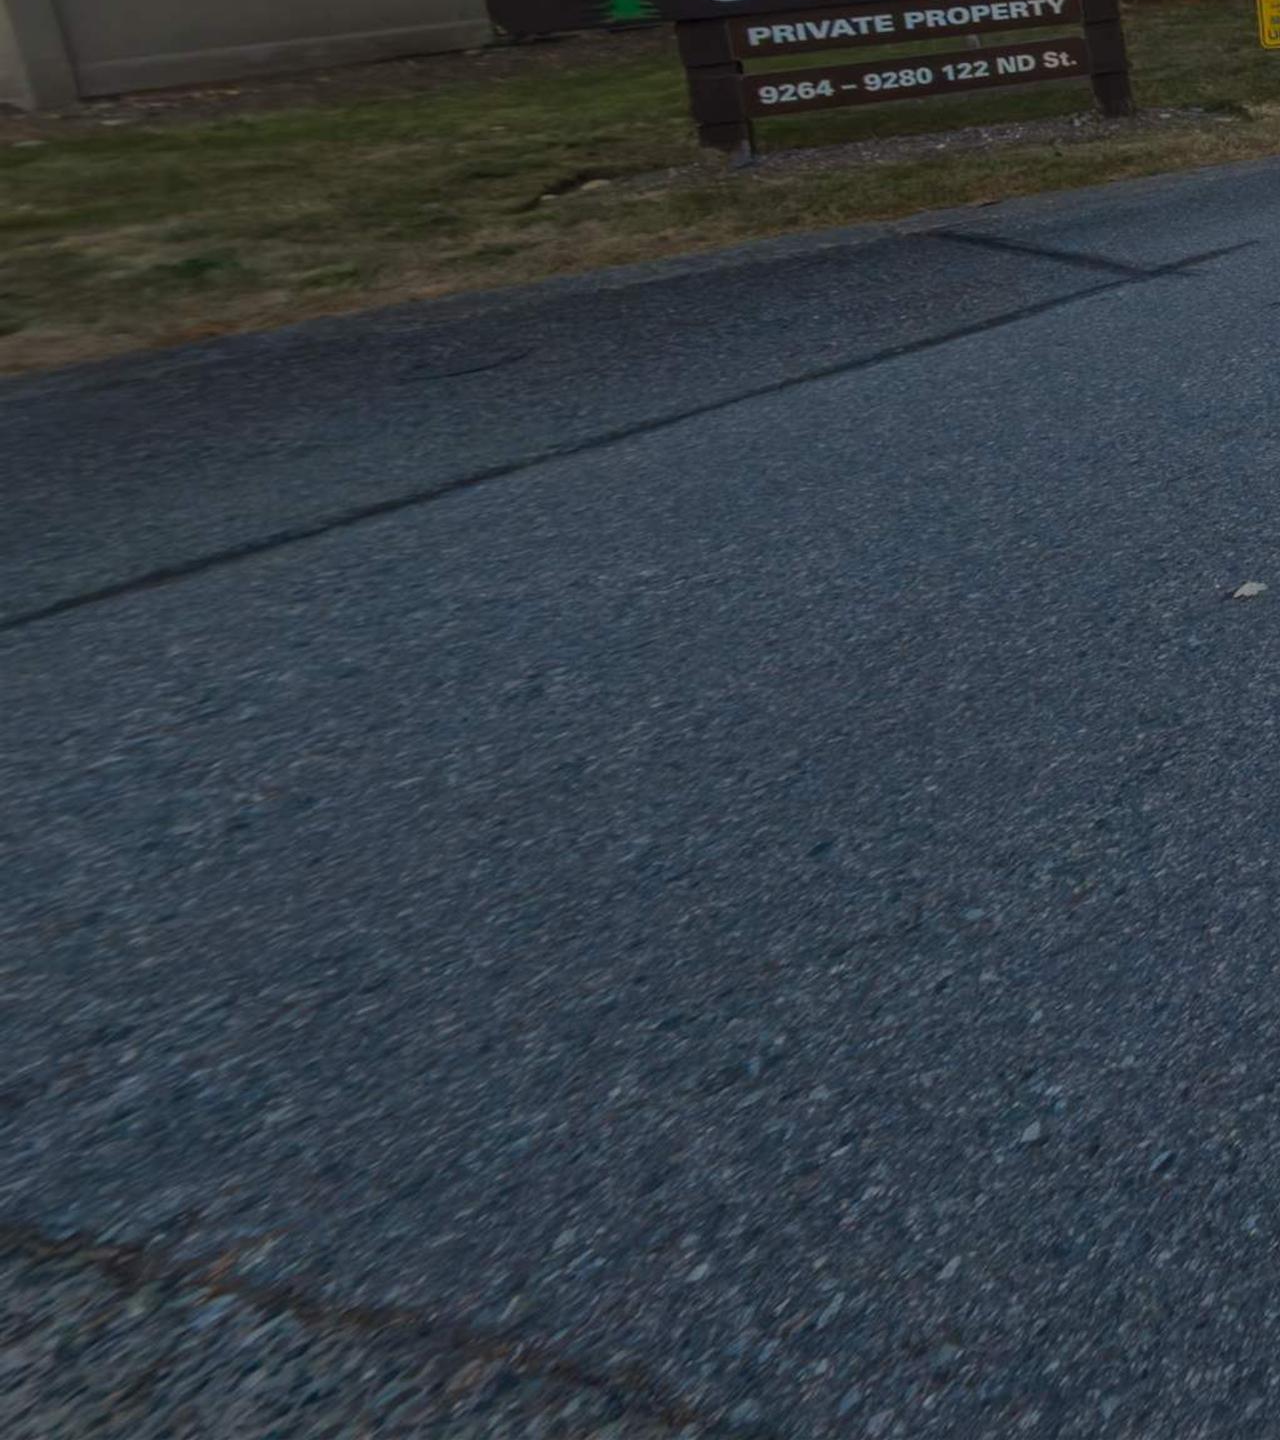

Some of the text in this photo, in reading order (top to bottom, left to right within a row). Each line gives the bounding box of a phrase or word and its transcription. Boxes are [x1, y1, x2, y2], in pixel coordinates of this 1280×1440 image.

[747, 14, 895, 46] PRIVATE
[759, 79, 835, 105] 9264
[863, 67, 933, 93] 9280
[942, 60, 989, 81] 122
[996, 54, 1036, 75] ND
[1043, 50, 1077, 68] St.
